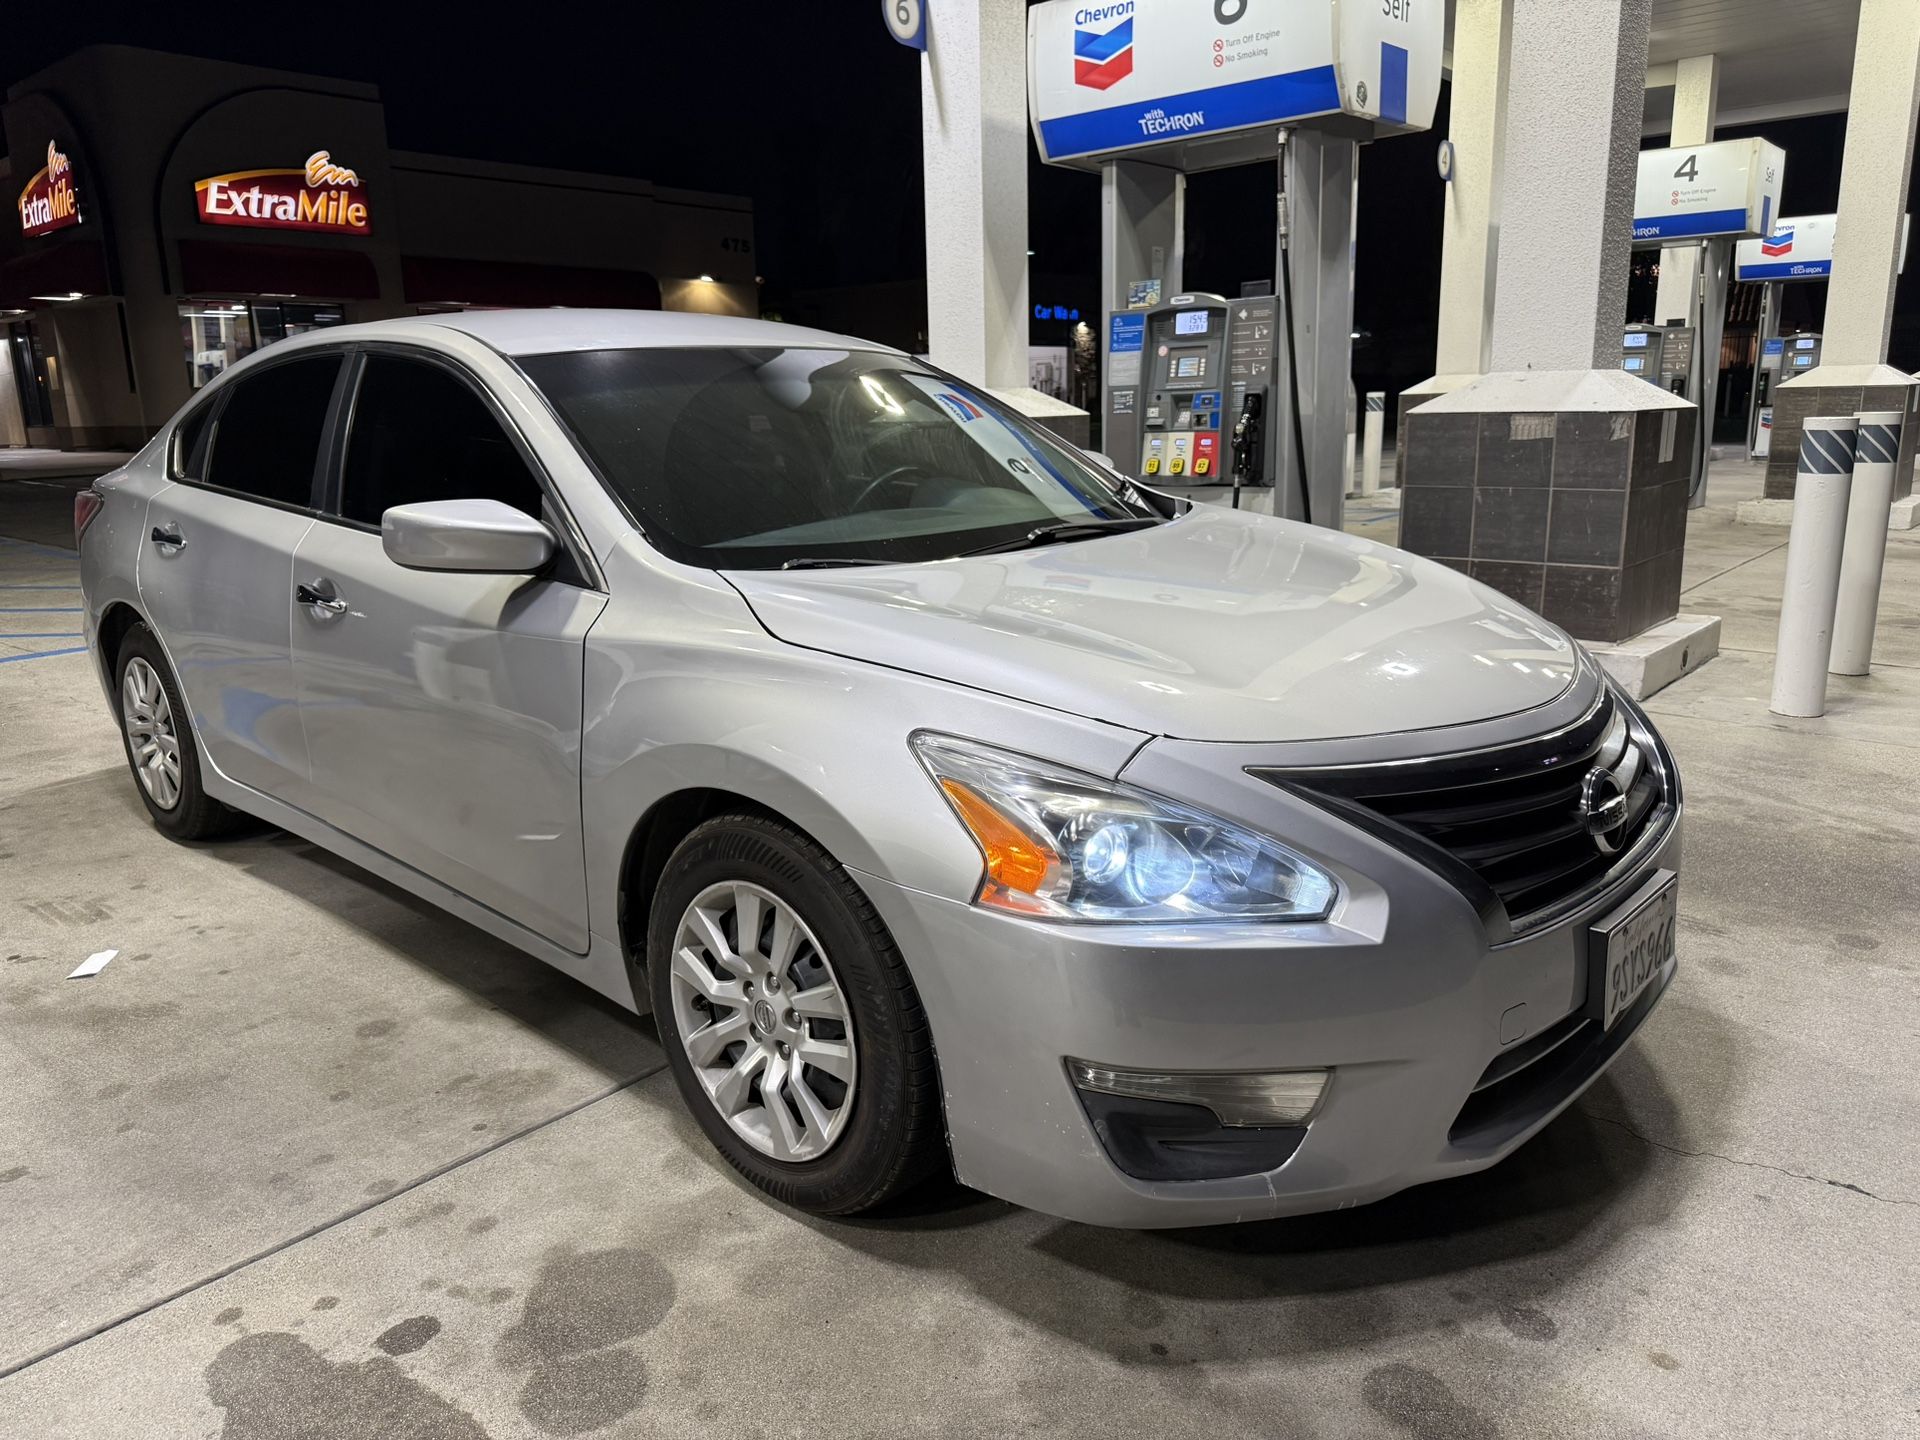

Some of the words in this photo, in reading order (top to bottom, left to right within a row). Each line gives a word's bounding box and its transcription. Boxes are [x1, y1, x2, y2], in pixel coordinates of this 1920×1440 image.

[896, 0, 910, 26] 6
[1074, 0, 1135, 26] Chevron
[1225, 38, 1241, 48] Turn
[1242, 33, 1254, 44] Off
[1255, 29, 1281, 41] Engine
[1225, 54, 1235, 62] No
[1236, 48, 1268, 61] Smoking
[1137, 110, 1205, 136] TECHRON
[1143, 108, 1165, 120] with
[1441, 151, 1447, 168] 4
[1673, 154, 1699, 183] 4
[22, 178, 76, 230] ExtraMile
[205, 180, 368, 227] ExtraMile
[721, 237, 751, 254] 475
[1790, 266, 1823, 275] TECHRON
[1034, 304, 1051, 319] Car
[1610, 915, 1674, 1014] 9SYS966
